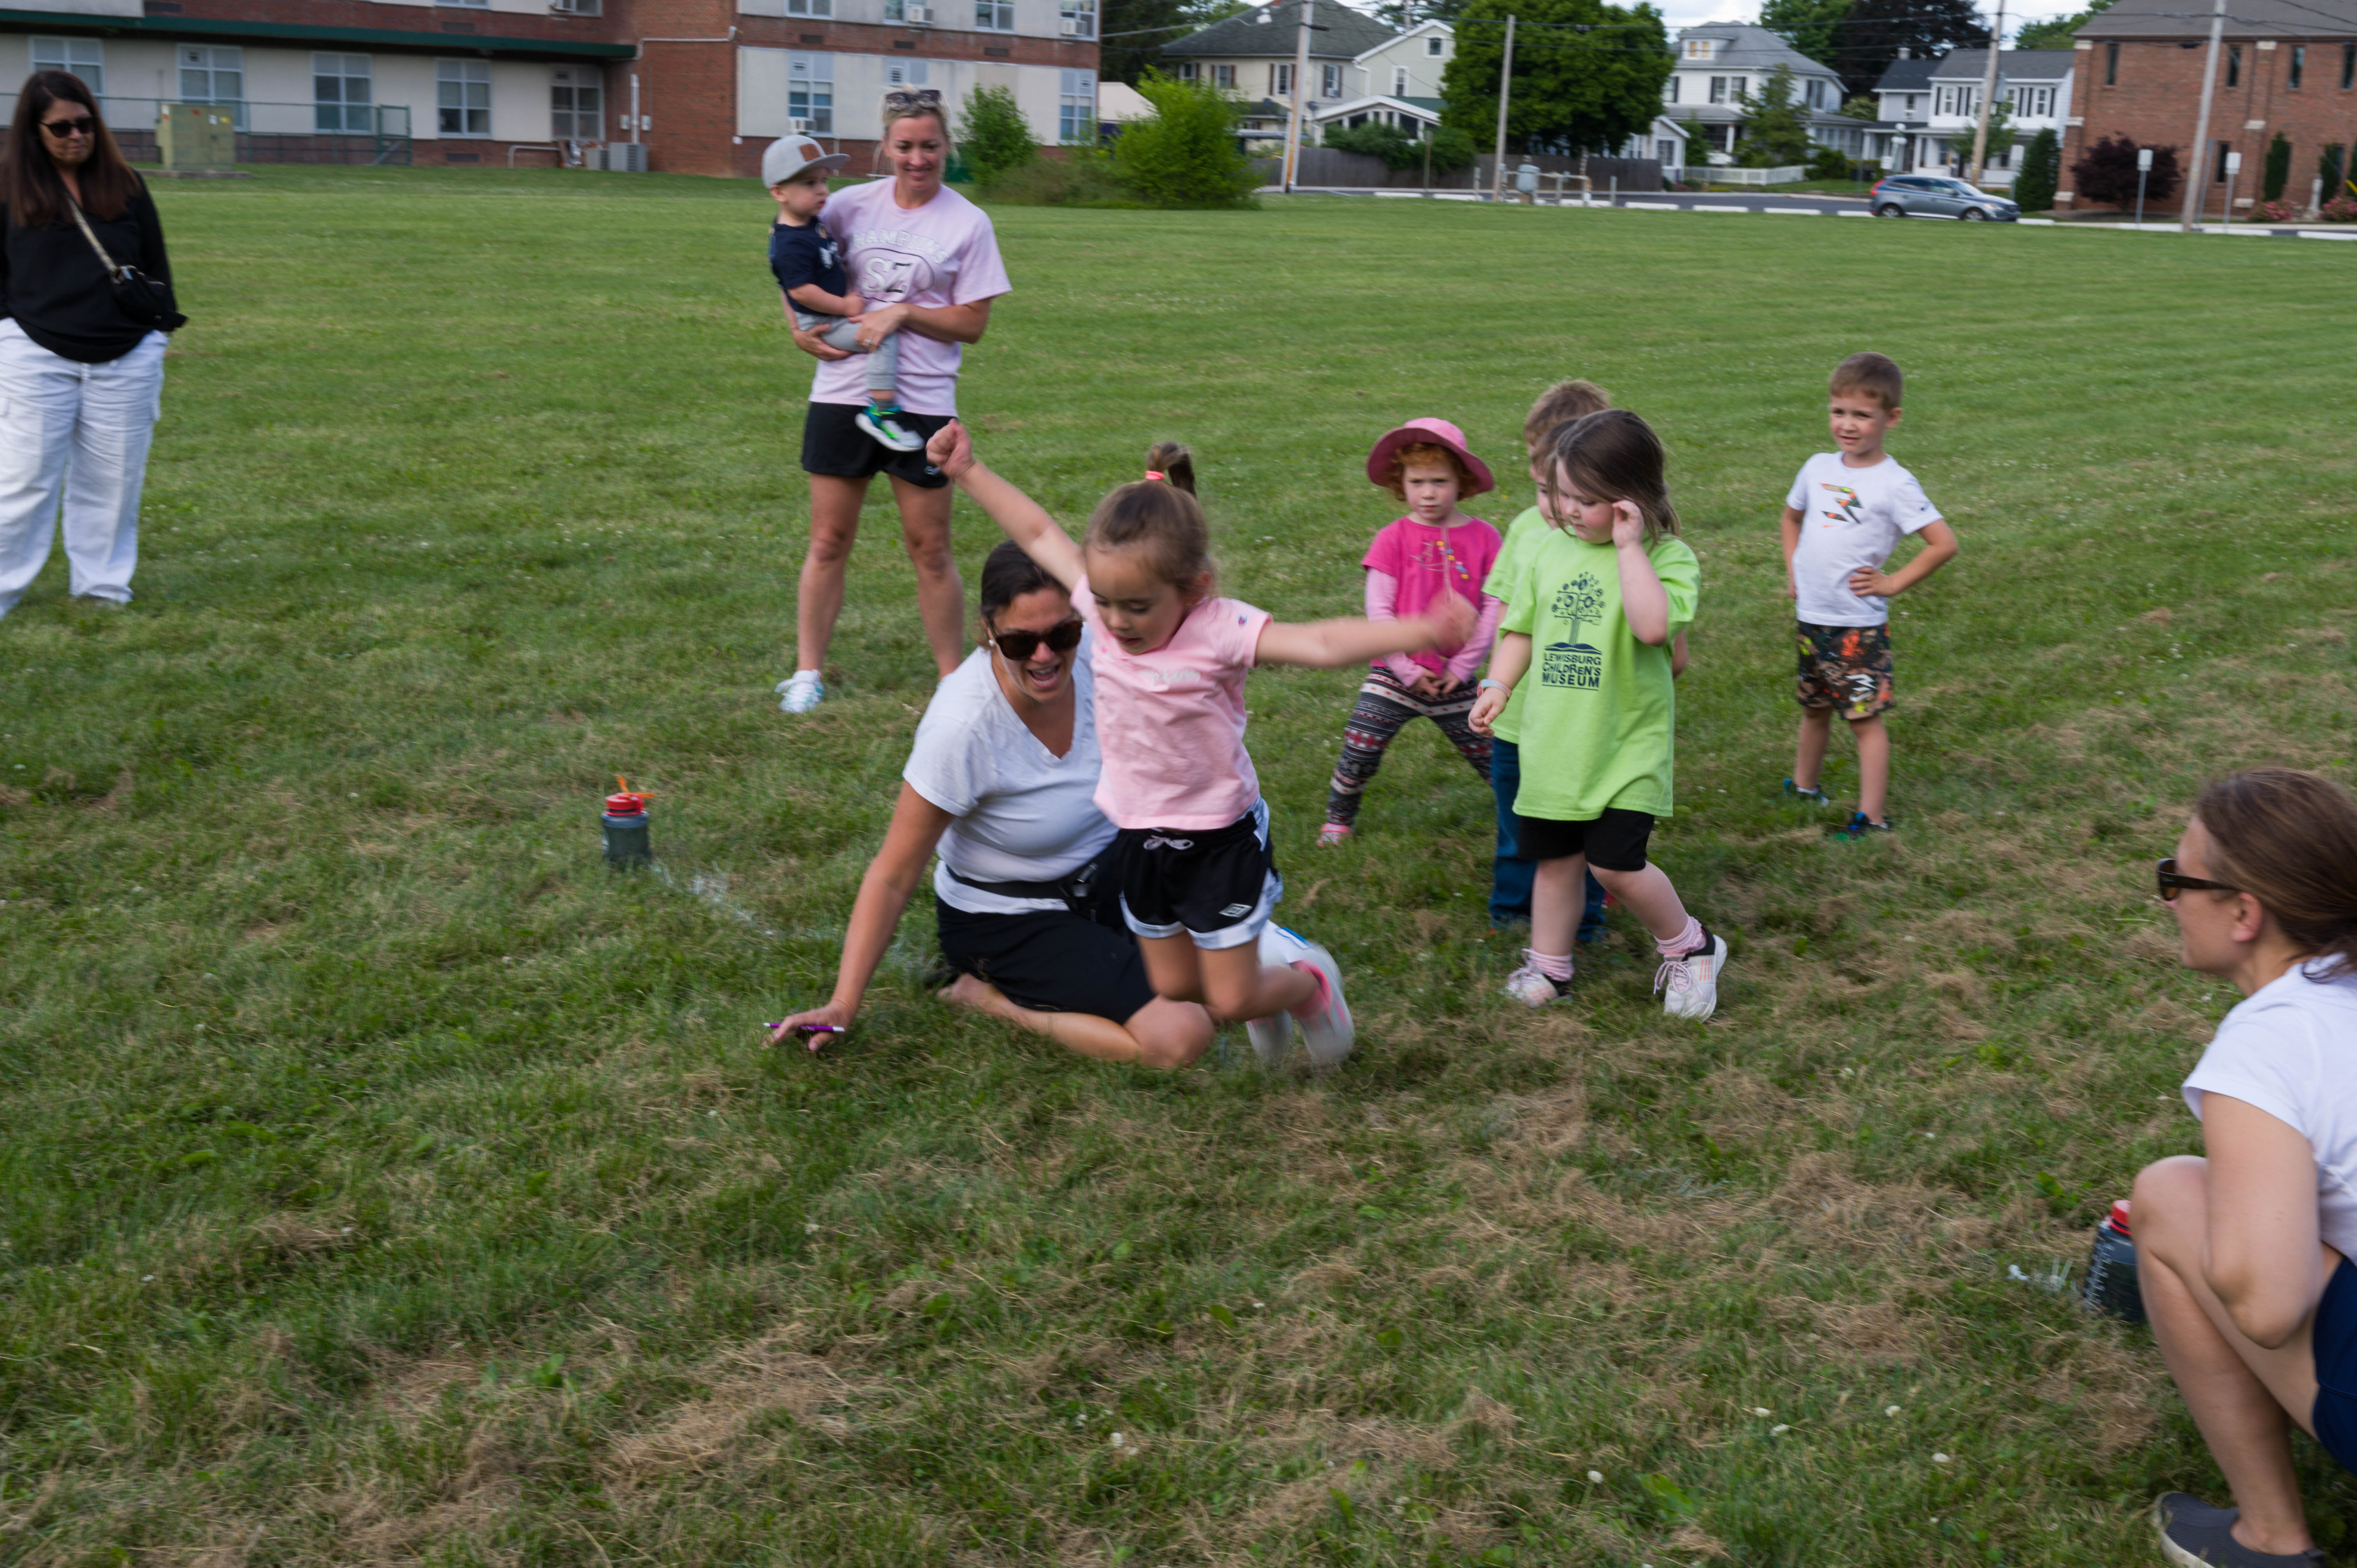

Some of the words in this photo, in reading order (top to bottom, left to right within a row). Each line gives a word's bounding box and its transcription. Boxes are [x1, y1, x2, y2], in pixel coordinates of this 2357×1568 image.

[1544, 653, 1601, 665] LEWISBURG
[1542, 662, 1601, 676] CHILDREN'S
[1542, 673, 1599, 687] MUSEUM
